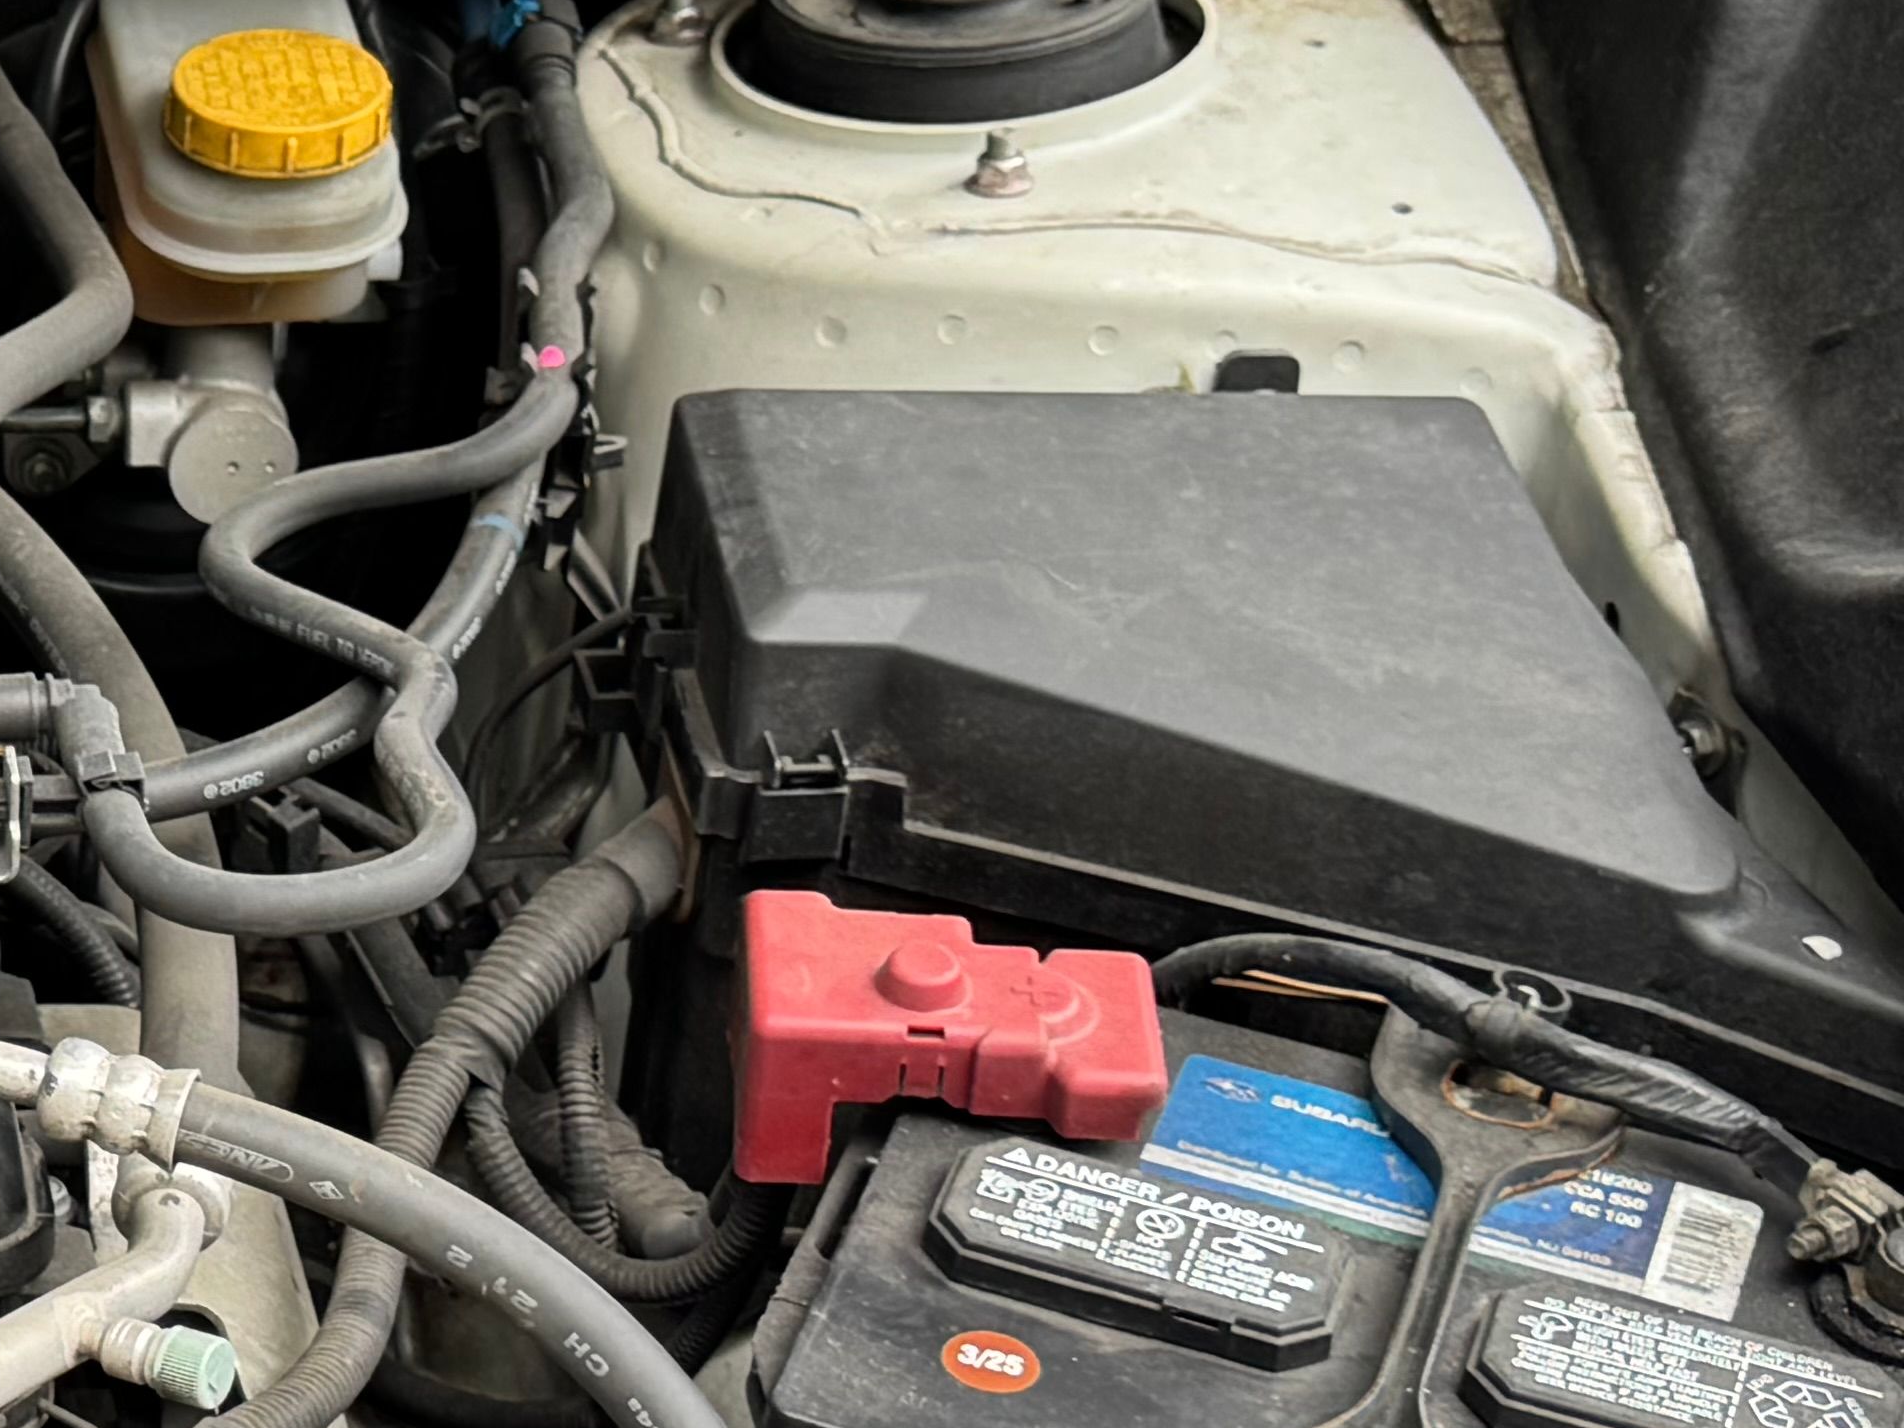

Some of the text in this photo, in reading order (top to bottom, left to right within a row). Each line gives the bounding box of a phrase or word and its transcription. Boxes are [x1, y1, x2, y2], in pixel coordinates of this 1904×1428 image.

[1036, 1154, 1161, 1202] DANGER
[1189, 1196, 1305, 1240] POISON
[957, 1343, 1024, 1376] 3/25
